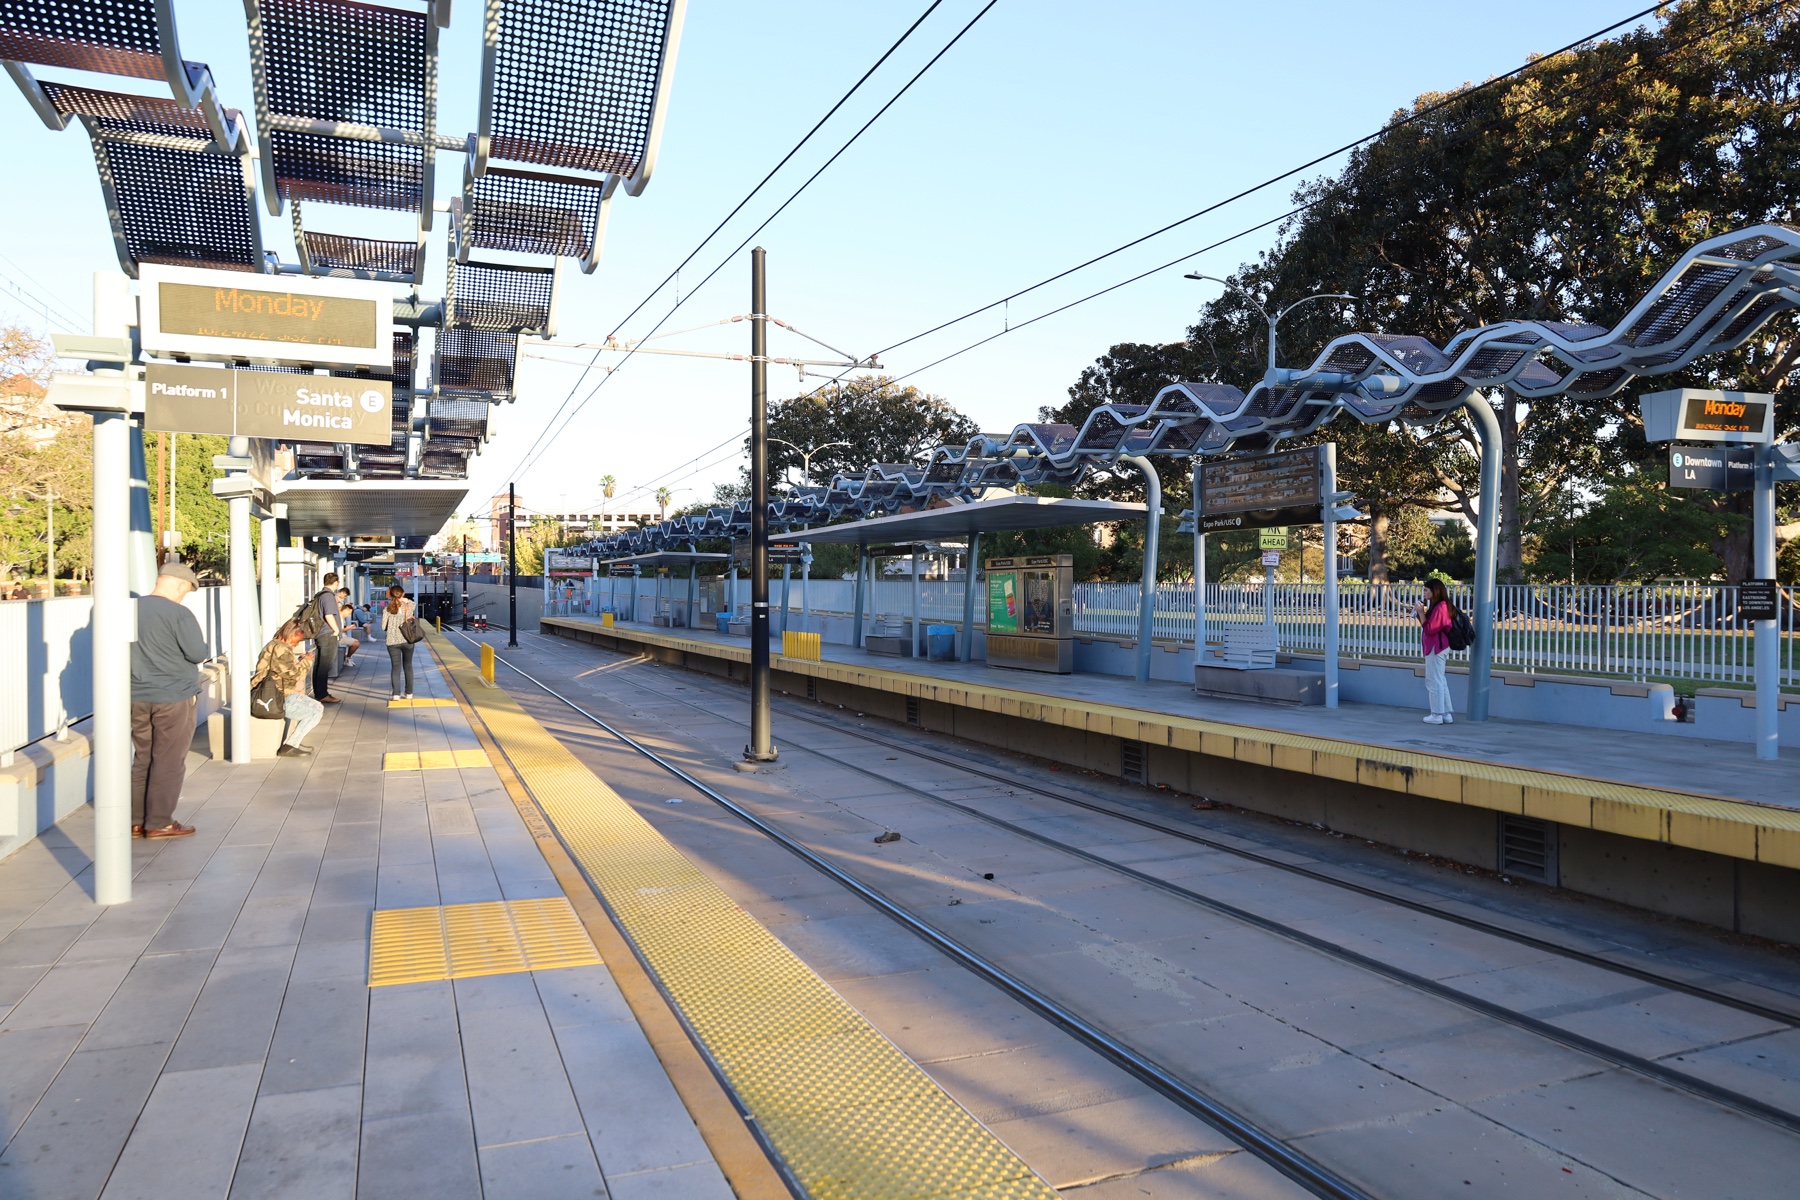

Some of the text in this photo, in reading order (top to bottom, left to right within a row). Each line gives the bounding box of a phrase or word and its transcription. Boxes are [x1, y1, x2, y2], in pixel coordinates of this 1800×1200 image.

[215, 289, 324, 320] Monday
[151, 382, 228, 399] Platform 1
[296, 388, 353, 408] Santa
[1704, 400, 1746, 417] Monday
[283, 408, 353, 430] Monica
[1684, 455, 1723, 468] Downtown
[1728, 461, 1749, 470] Platform
[1684, 469, 1696, 480] LA
[1203, 521, 1214, 529] Expo
[1214, 518, 1236, 527] Park/USC
[1261, 538, 1286, 546] AHEAD
